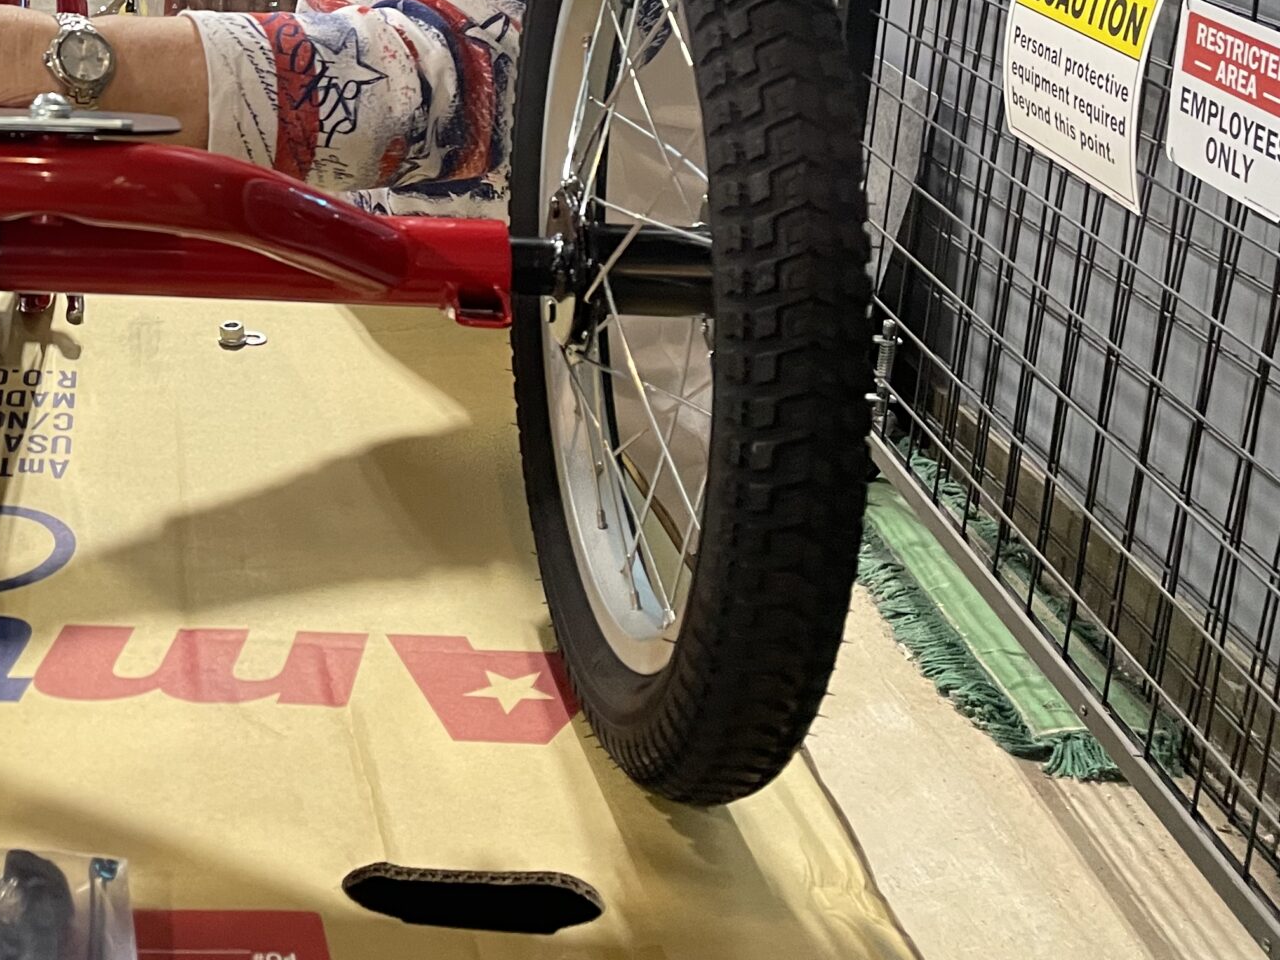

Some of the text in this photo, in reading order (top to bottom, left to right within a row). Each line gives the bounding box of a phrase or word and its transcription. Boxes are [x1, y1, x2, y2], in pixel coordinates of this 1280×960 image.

[1013, 25, 1129, 102] Personal protective
[1196, 21, 1280, 82] RESTRICTE
[1214, 60, 1258, 100] AREA
[1011, 60, 1126, 137] equipment required
[1011, 85, 1116, 165] beyond this point.
[1179, 86, 1280, 162] EMPLOYEE
[1205, 136, 1255, 184] ONLY
[4, 434, 72, 455] USA
